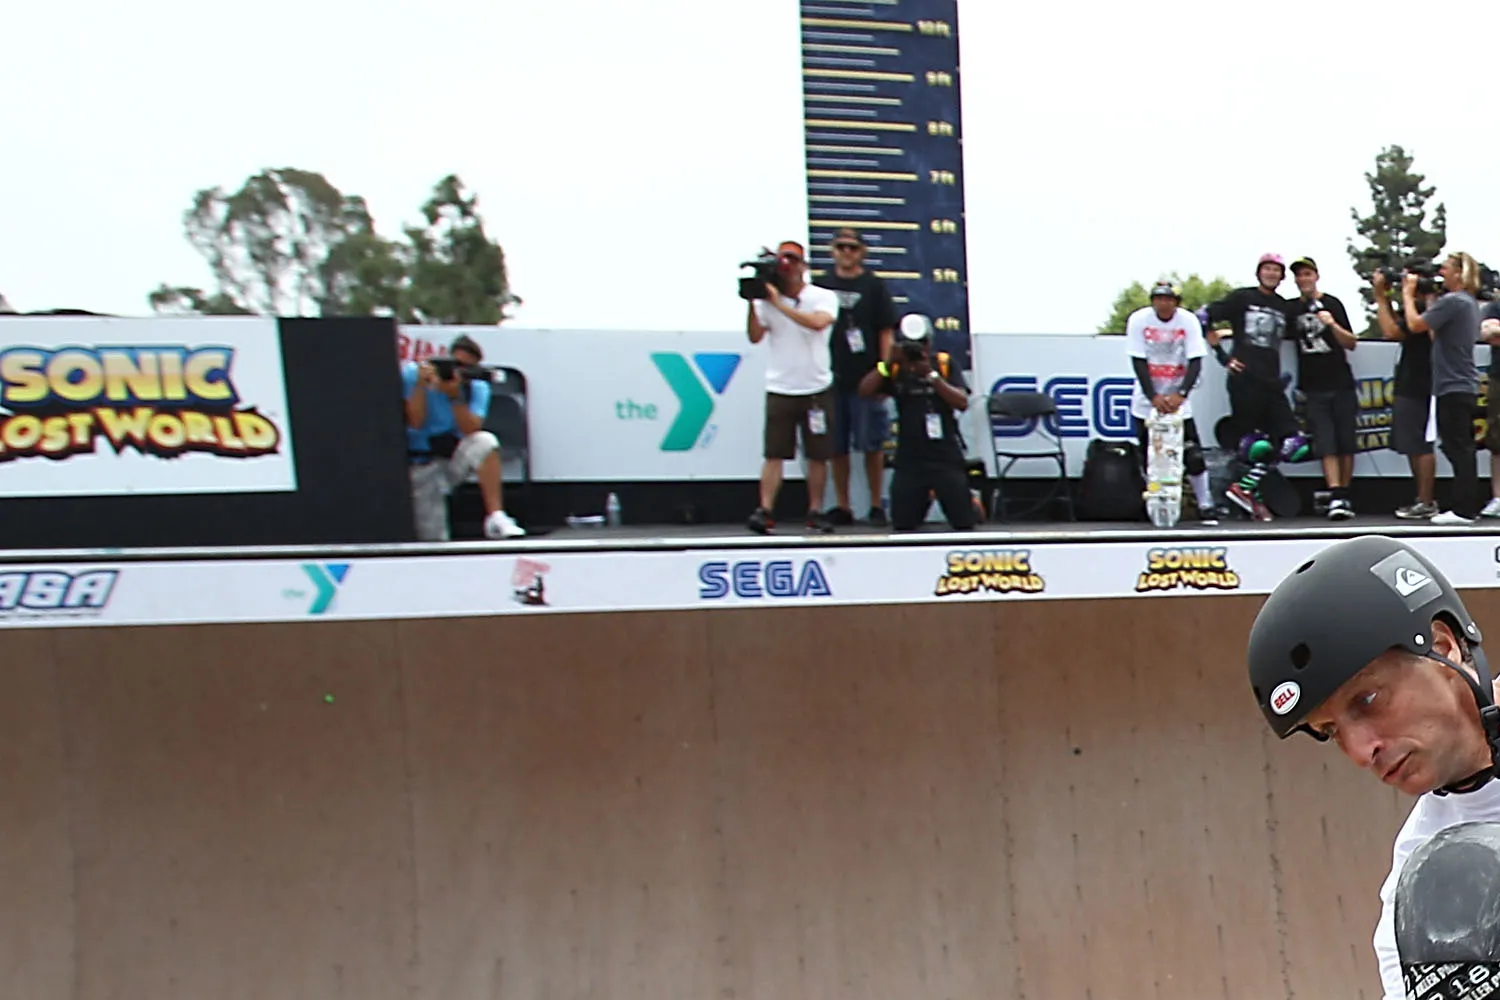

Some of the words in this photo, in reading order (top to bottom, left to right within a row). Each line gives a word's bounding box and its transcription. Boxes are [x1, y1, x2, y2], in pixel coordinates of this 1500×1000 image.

[0, 348, 236, 402] SONIC
[615, 399, 657, 420] the
[992, 377, 1138, 437] SEG
[0, 412, 94, 451] OST
[97, 406, 278, 450] WORLD
[948, 550, 1030, 572] SONIC
[1148, 548, 1227, 569] SONIC
[700, 560, 831, 599] SEGA
[935, 574, 979, 594] LOST
[979, 572, 1044, 592] WORLD
[1136, 572, 1178, 590] LOST
[1179, 570, 1240, 588] WORLD
[1274, 688, 1296, 709] BELL
